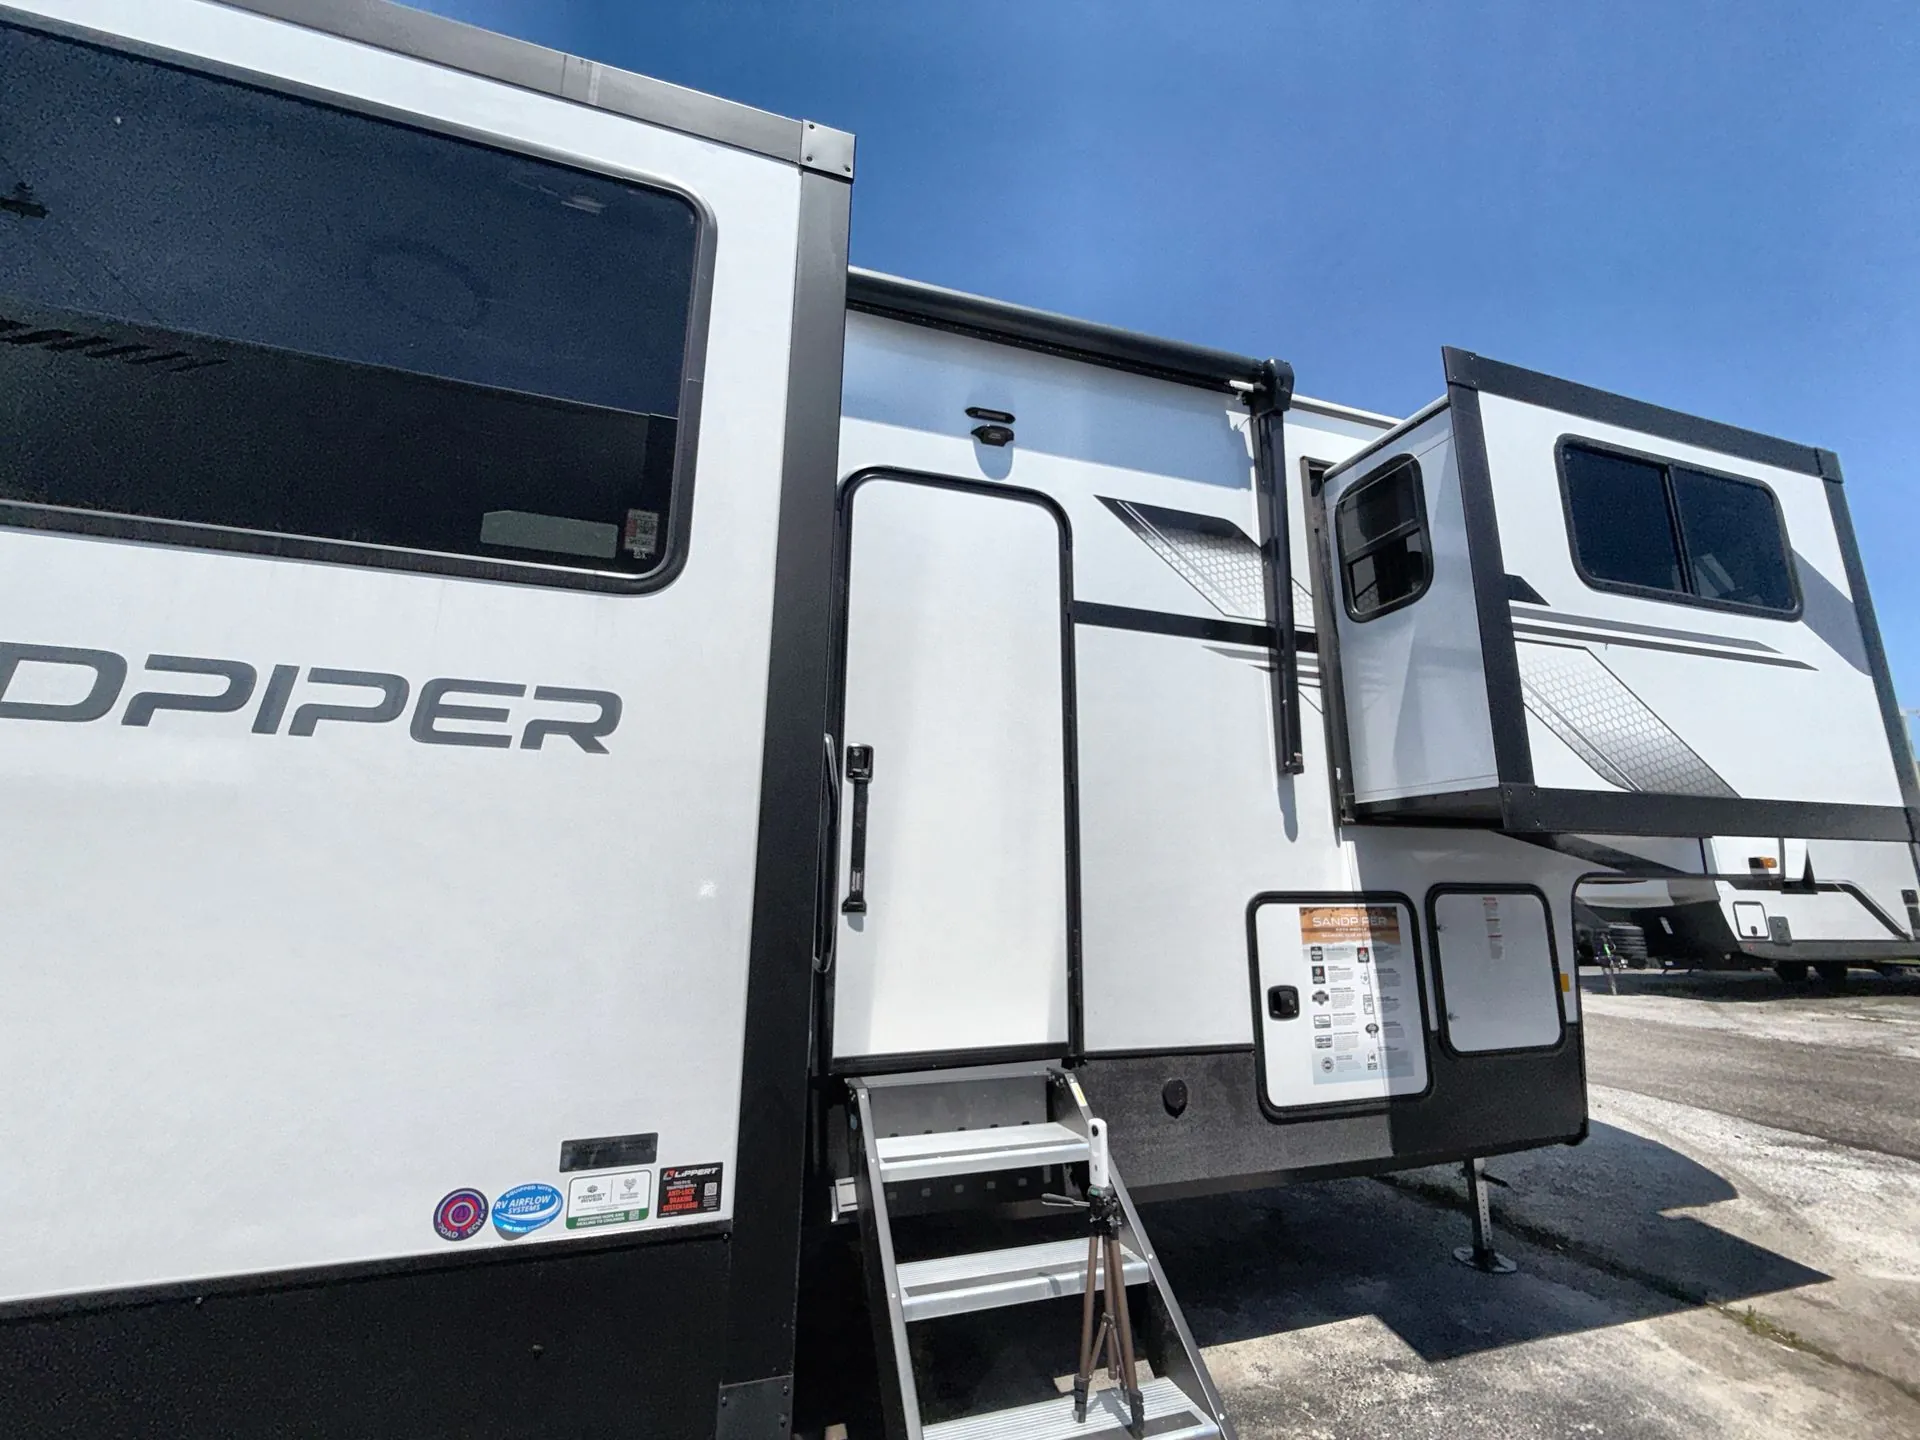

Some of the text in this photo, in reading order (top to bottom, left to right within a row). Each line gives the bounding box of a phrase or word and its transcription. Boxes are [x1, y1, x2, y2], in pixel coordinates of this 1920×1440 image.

[1312, 916, 1387, 928] SANDPPER
[495, 1194, 552, 1210] RV AIRFLOW
[508, 1204, 541, 1215] SYSTEMS
